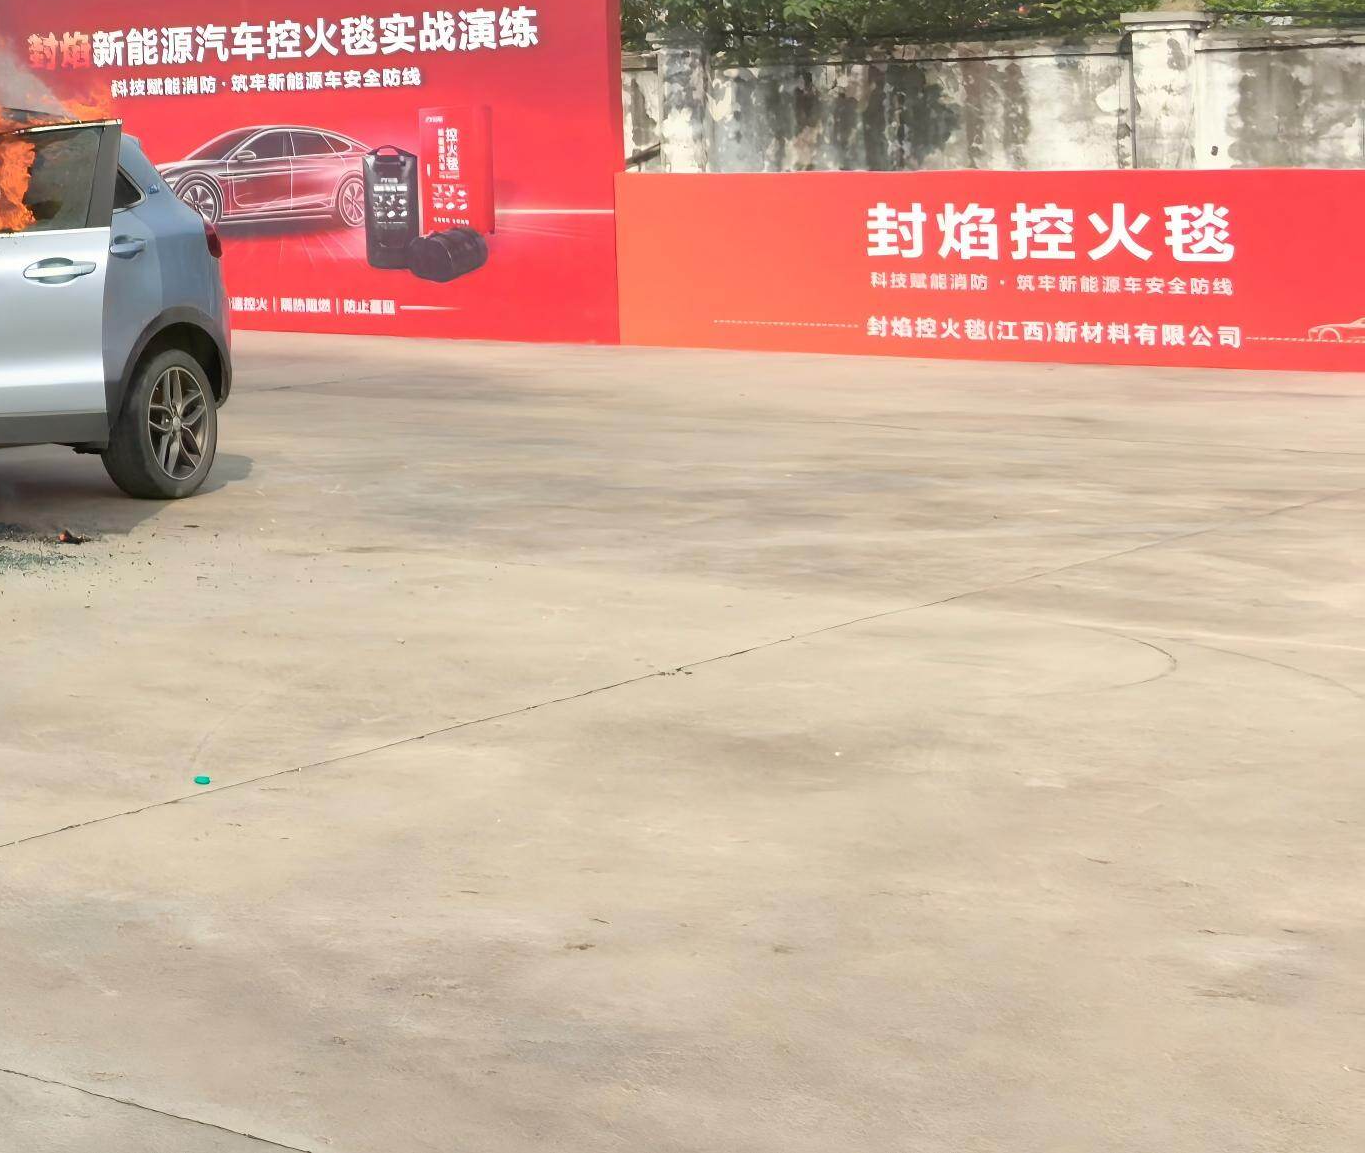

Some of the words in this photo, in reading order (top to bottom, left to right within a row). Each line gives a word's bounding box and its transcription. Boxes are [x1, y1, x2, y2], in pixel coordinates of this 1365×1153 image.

[27, 5, 539, 70] 封焰新能源汽车控火毯实战演练
[866, 202, 1235, 263] 封焰控火毯
[228, 296, 269, 312] 速控火
